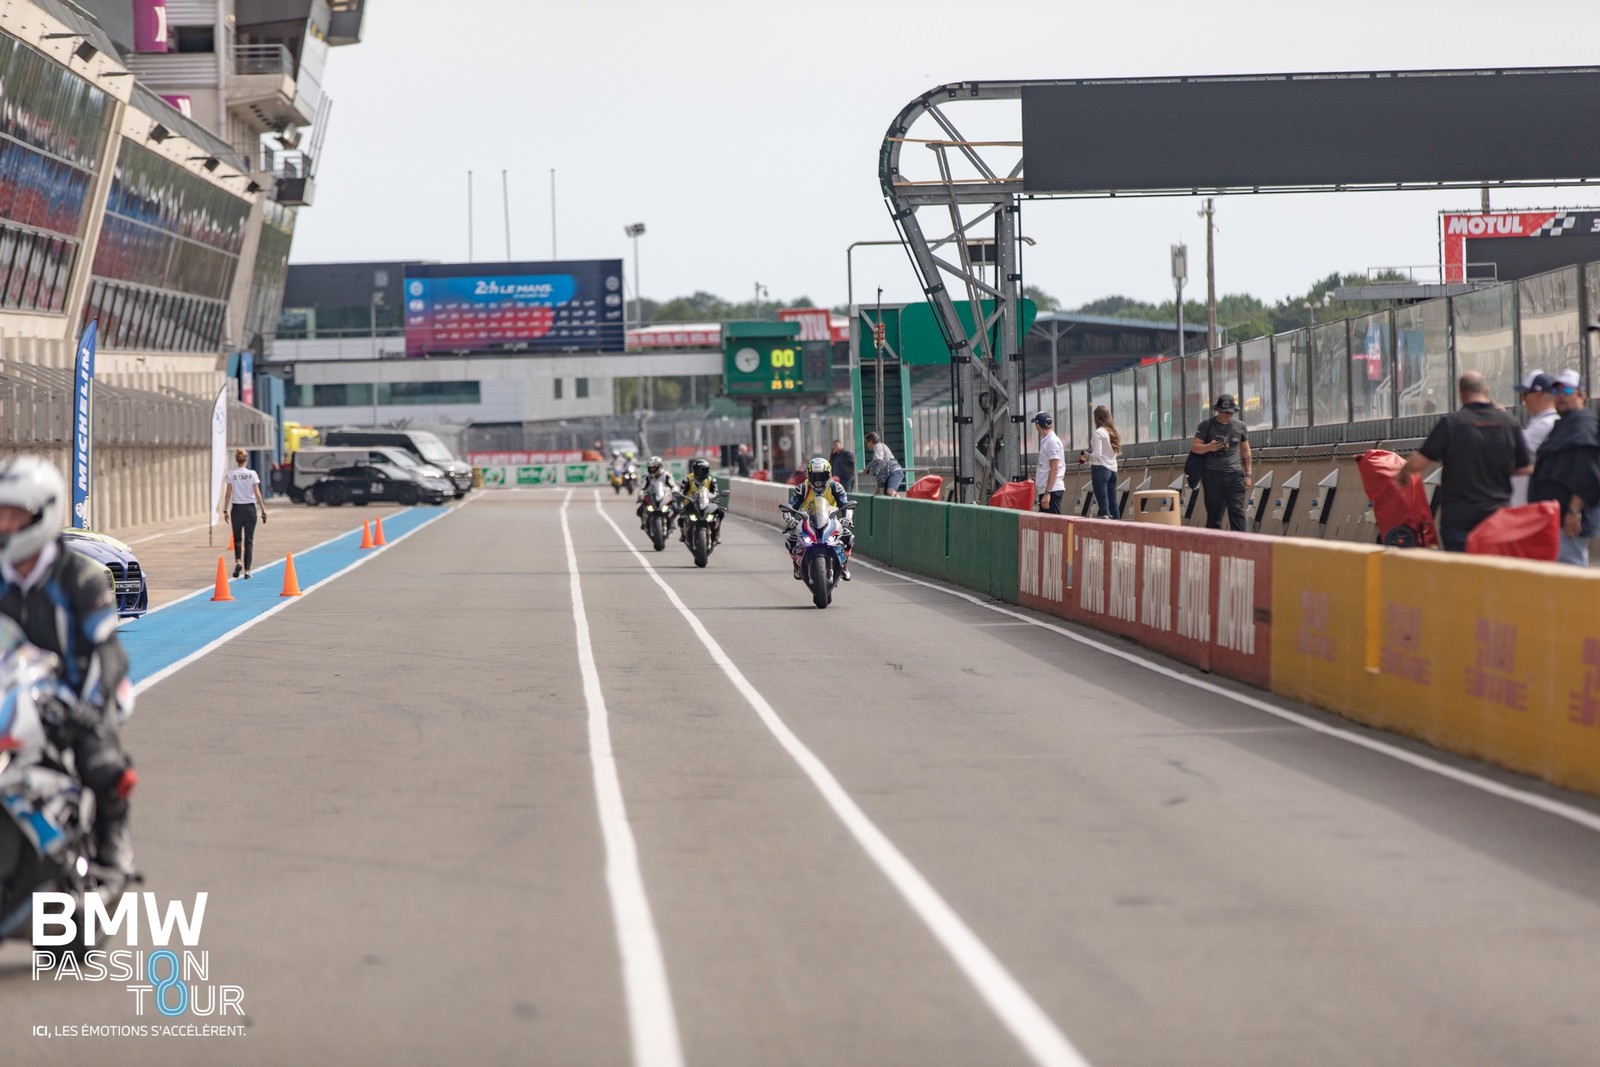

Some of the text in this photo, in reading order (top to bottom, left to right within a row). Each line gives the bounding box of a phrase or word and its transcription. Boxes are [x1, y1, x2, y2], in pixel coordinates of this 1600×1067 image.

[1448, 215, 1523, 235] MOTUL
[771, 349, 795, 368] 00
[78, 347, 90, 491] MICHELIN
